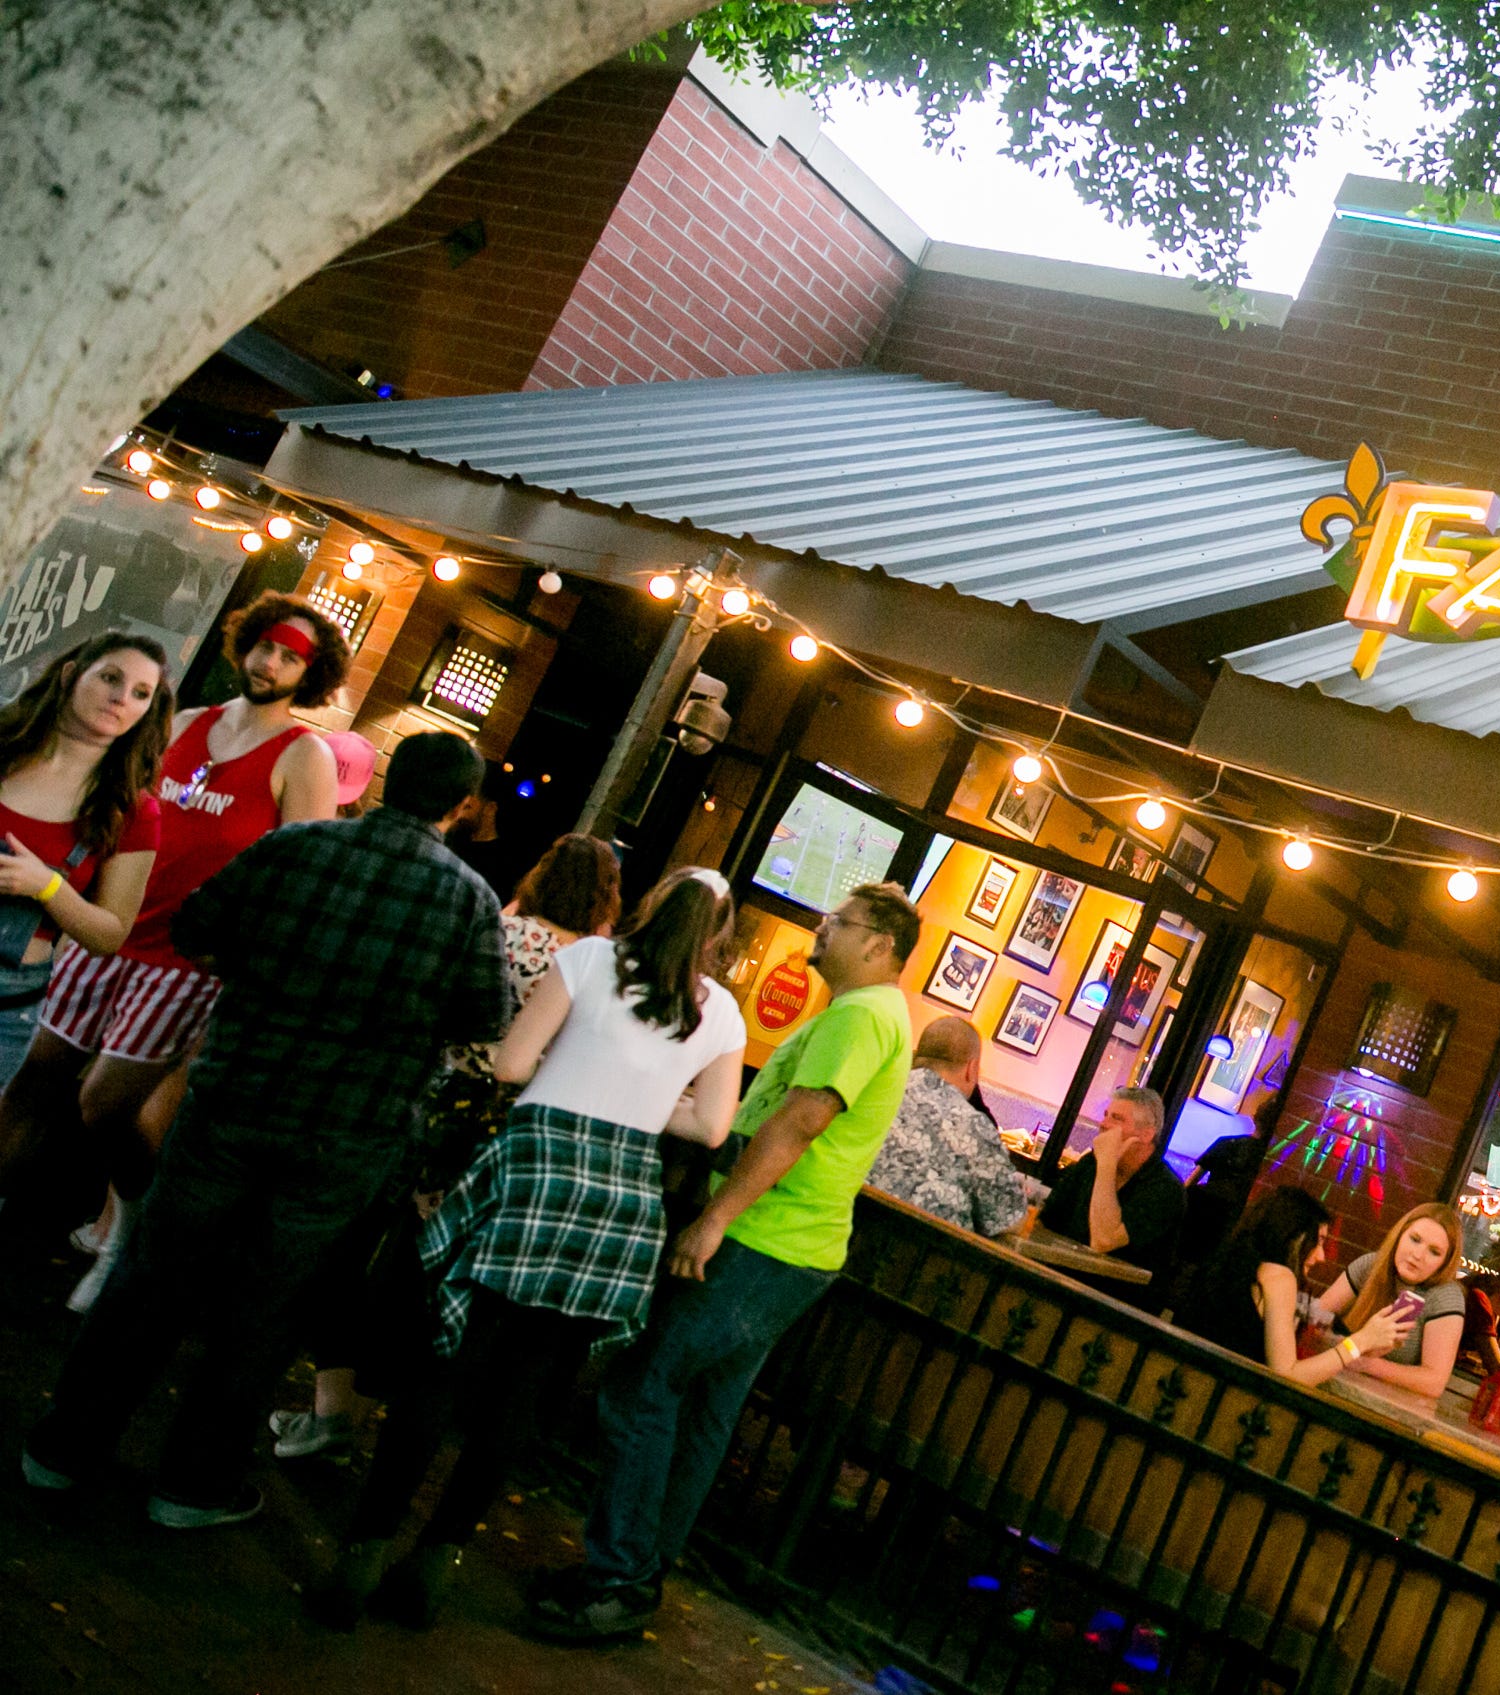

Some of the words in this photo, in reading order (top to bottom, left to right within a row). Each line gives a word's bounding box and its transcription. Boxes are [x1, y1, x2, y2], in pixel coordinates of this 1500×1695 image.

[6, 550, 73, 617] AFT
[0, 594, 64, 665] EERS
[161, 775, 235, 816] SWTIN'
[761, 980, 804, 1011] Corona
